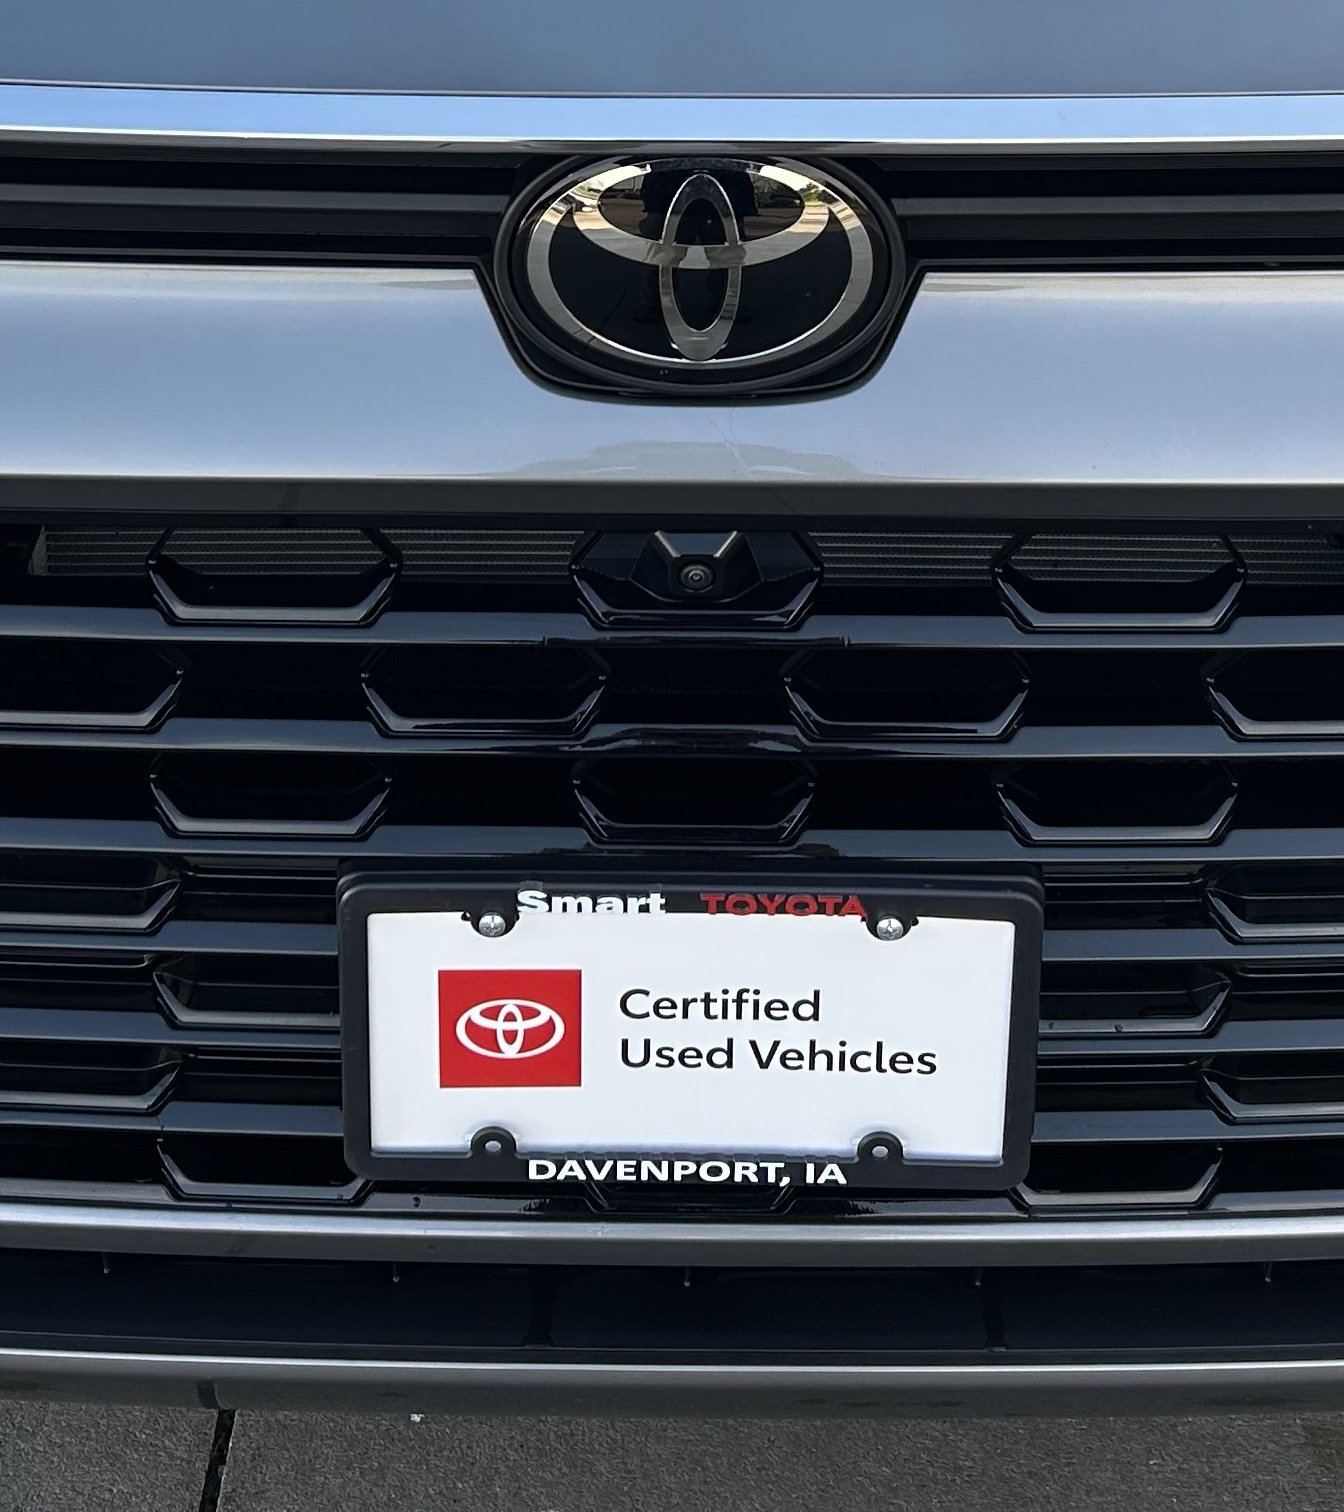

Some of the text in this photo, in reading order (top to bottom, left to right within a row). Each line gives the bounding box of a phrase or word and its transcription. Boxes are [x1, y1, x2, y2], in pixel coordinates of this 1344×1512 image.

[516, 889, 869, 918] Smart TOYOTA
[618, 987, 821, 1022] Certified
[620, 1037, 938, 1076] Used Vehicles
[527, 1159, 848, 1187] DAVENPORT, IA
